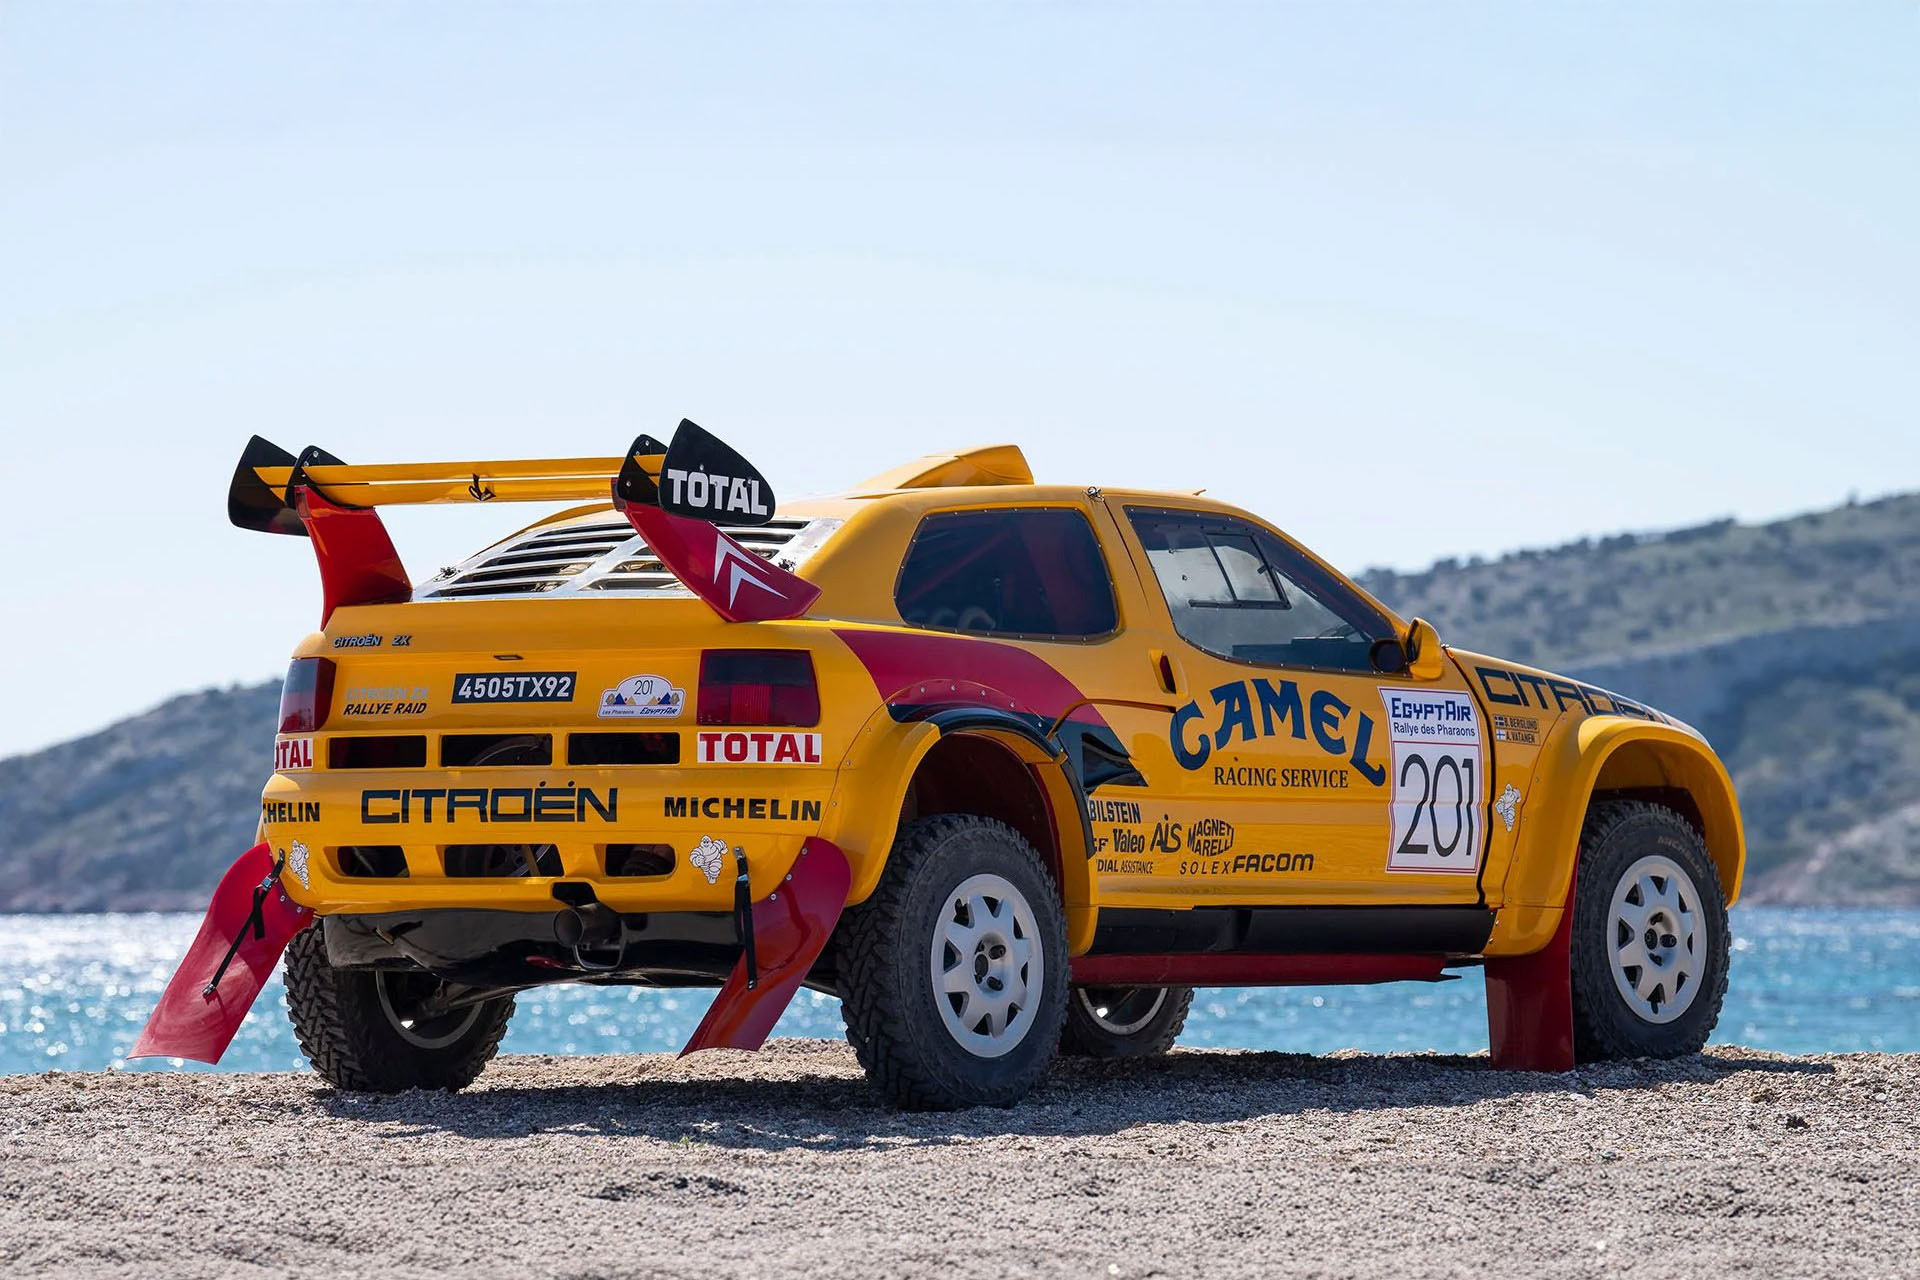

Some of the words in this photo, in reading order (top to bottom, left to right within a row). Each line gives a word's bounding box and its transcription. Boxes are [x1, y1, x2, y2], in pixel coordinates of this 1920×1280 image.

[667, 468, 768, 516] TOTAL
[458, 676, 572, 699] 4505TX92
[634, 680, 653, 695] 201
[344, 703, 392, 715] RALLYE
[394, 703, 427, 714] RAID
[1170, 678, 1386, 787] CAMEL
[1393, 722, 1419, 736] Rallye
[1421, 723, 1436, 735] des
[1437, 724, 1476, 736] Pharaons
[699, 733, 820, 763] TOTAL
[1214, 766, 1277, 787] RACING
[1281, 769, 1349, 788] SERVICE
[664, 796, 821, 821] MICHELIN
[1089, 800, 1142, 824] BILSTEIN
[1397, 754, 1474, 857] 201
[1112, 828, 1145, 854] Valeo
[1096, 858, 1118, 872] DIAL
[1120, 860, 1153, 874] ASSISTANCE
[1179, 861, 1231, 874] SOLEX
[1232, 853, 1314, 873] FACOM
